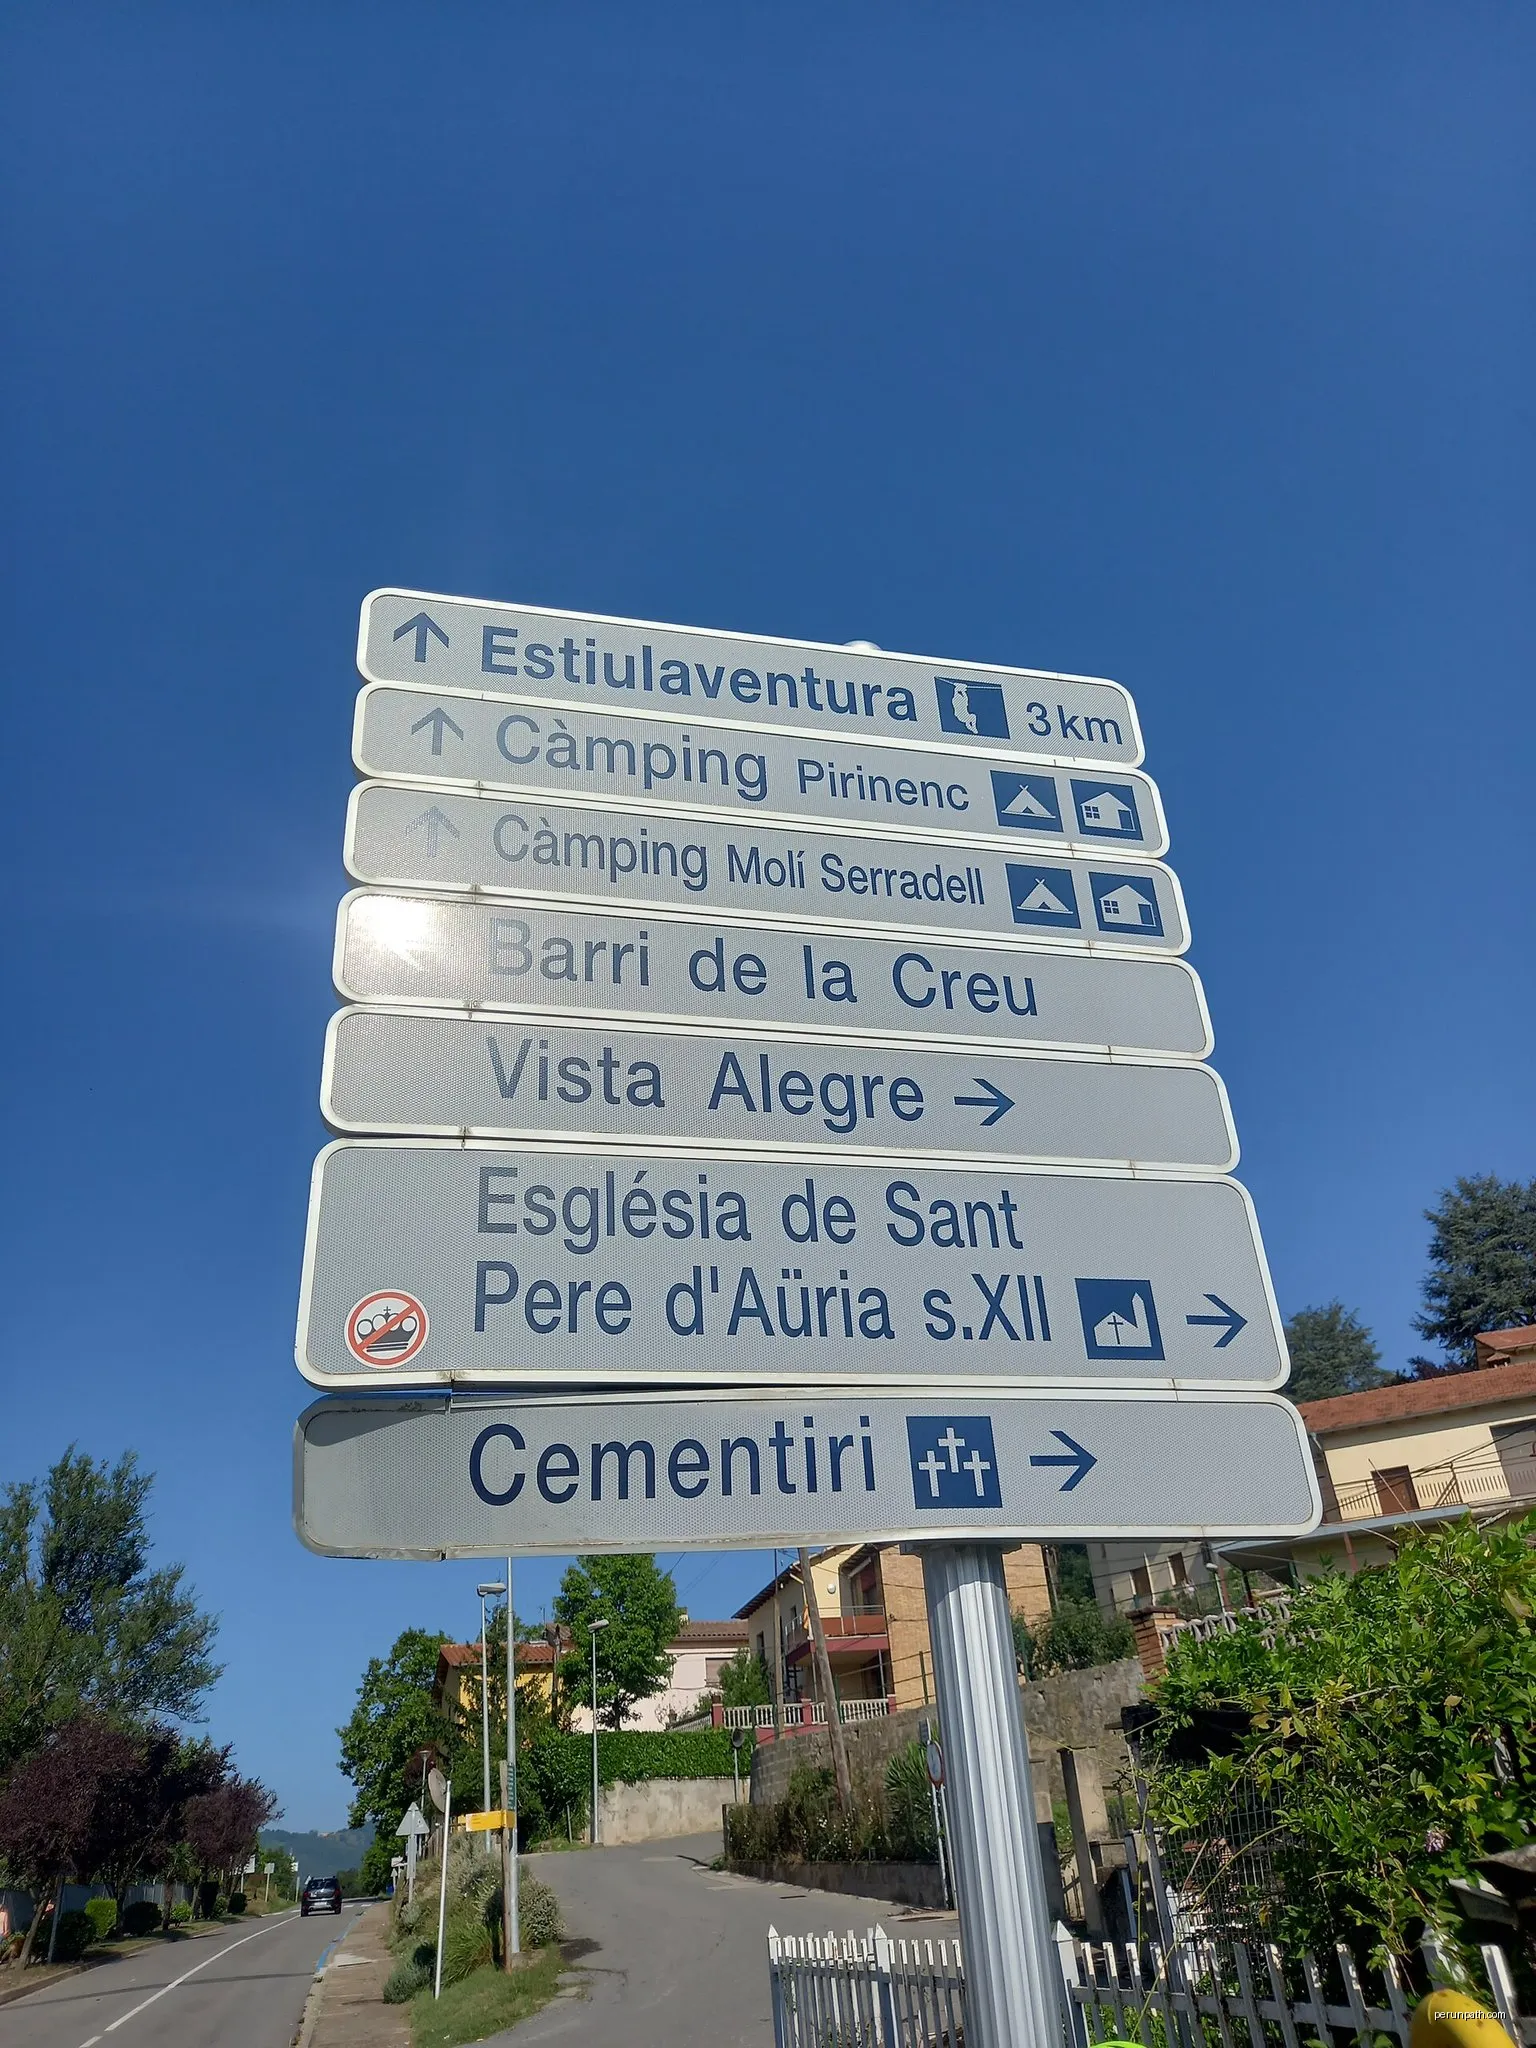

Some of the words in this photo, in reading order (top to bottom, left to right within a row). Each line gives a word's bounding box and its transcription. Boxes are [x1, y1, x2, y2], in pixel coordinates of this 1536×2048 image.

[481, 626, 918, 722] Estiulaventura
[496, 714, 768, 802] Càmping
[798, 758, 970, 811] Pirinenc
[493, 814, 709, 892] Càmping
[727, 844, 806, 890] Molí
[821, 852, 986, 906] Serradell
[490, 917, 651, 985] Barri
[689, 937, 768, 994] de
[803, 945, 858, 1003] la
[892, 953, 1037, 1018] Creu
[486, 1036, 666, 1108] Vista
[708, 1052, 925, 1133] Alegre
[477, 1165, 752, 1254] Església
[782, 1179, 857, 1245] de
[886, 1181, 1024, 1250] Sant
[474, 1260, 632, 1334] Pere
[666, 1265, 895, 1340] d'Aüria
[468, 1415, 876, 1507] Cementiri
